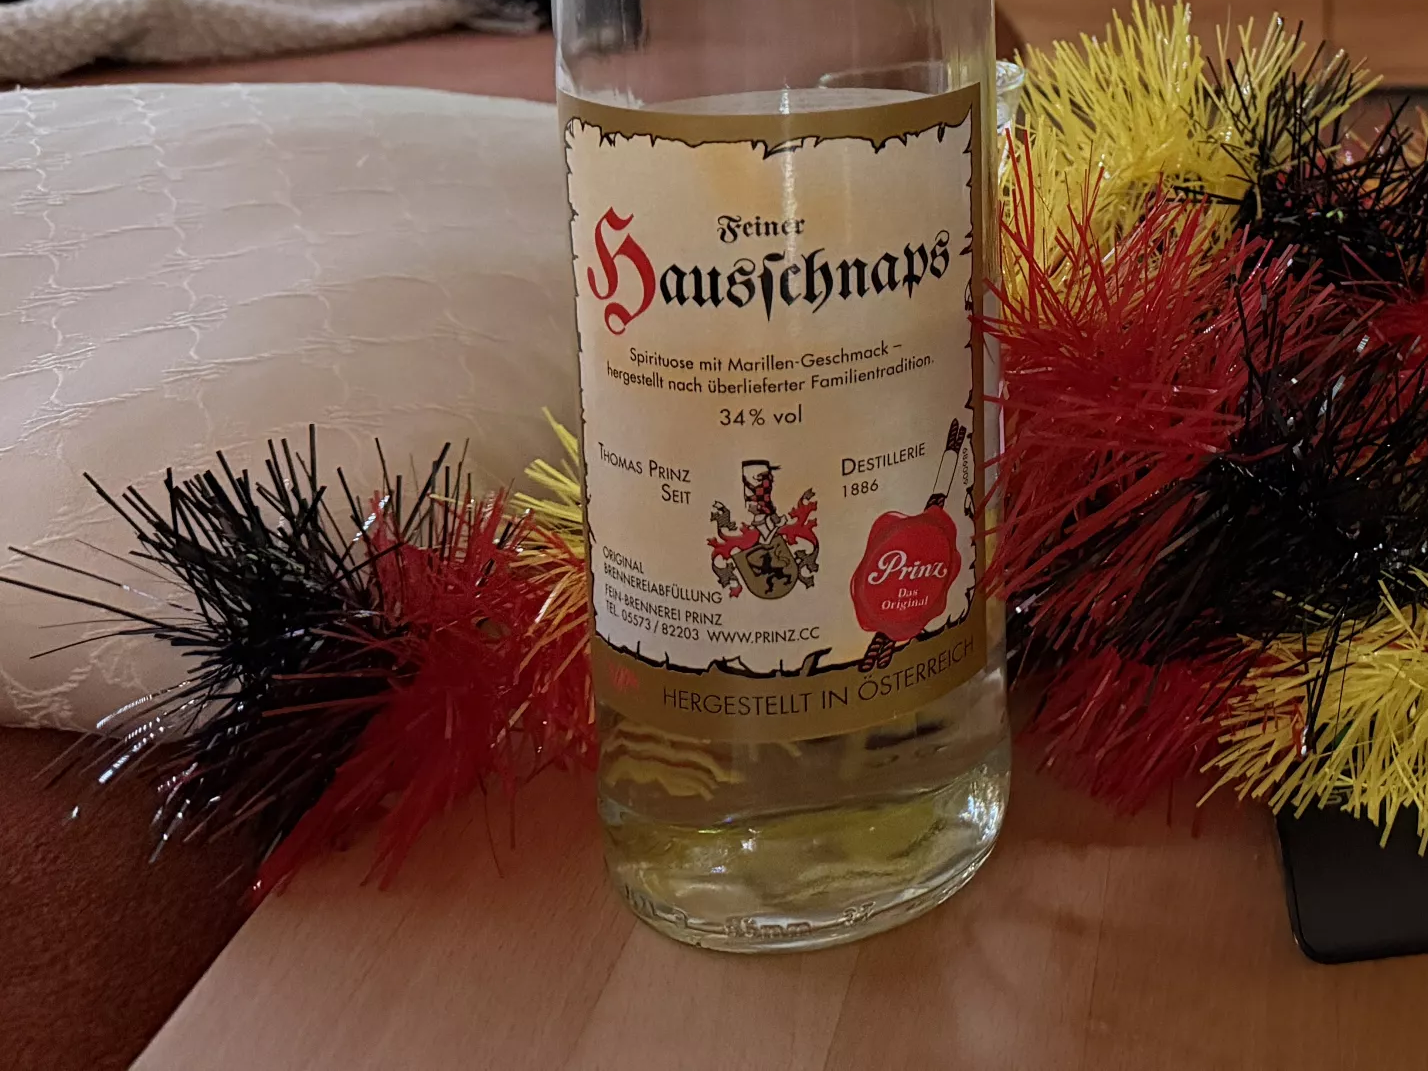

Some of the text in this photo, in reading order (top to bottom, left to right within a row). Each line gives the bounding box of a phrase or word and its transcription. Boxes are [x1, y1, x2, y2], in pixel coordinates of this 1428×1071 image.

[717, 214, 805, 243] Feiner
[629, 347, 694, 370] Spirituose
[700, 357, 722, 372] mit
[727, 339, 889, 372] Marillen-Geschmack
[606, 355, 935, 394] hergestellt nach überlieferter Familientradition.
[773, 404, 803, 425] vol
[598, 442, 926, 482] THOMAS PRINZ DESTILLERIE
[661, 479, 879, 504] SEIT 1886
[602, 546, 644, 574] ORIGINAL
[867, 550, 948, 585] Prinz
[603, 562, 723, 604] BRENNEREIABFÜLLUNG
[898, 588, 918, 598] Das
[605, 583, 723, 626] FEIN-BRENNEREI PRINZ
[881, 596, 928, 611] Original
[621, 610, 651, 630] 05573
[661, 624, 700, 641] 82203
[706, 627, 820, 644] WWW.PRINZ.CC
[663, 637, 974, 715] HERGESTELLT IN ÖSTERREICH
